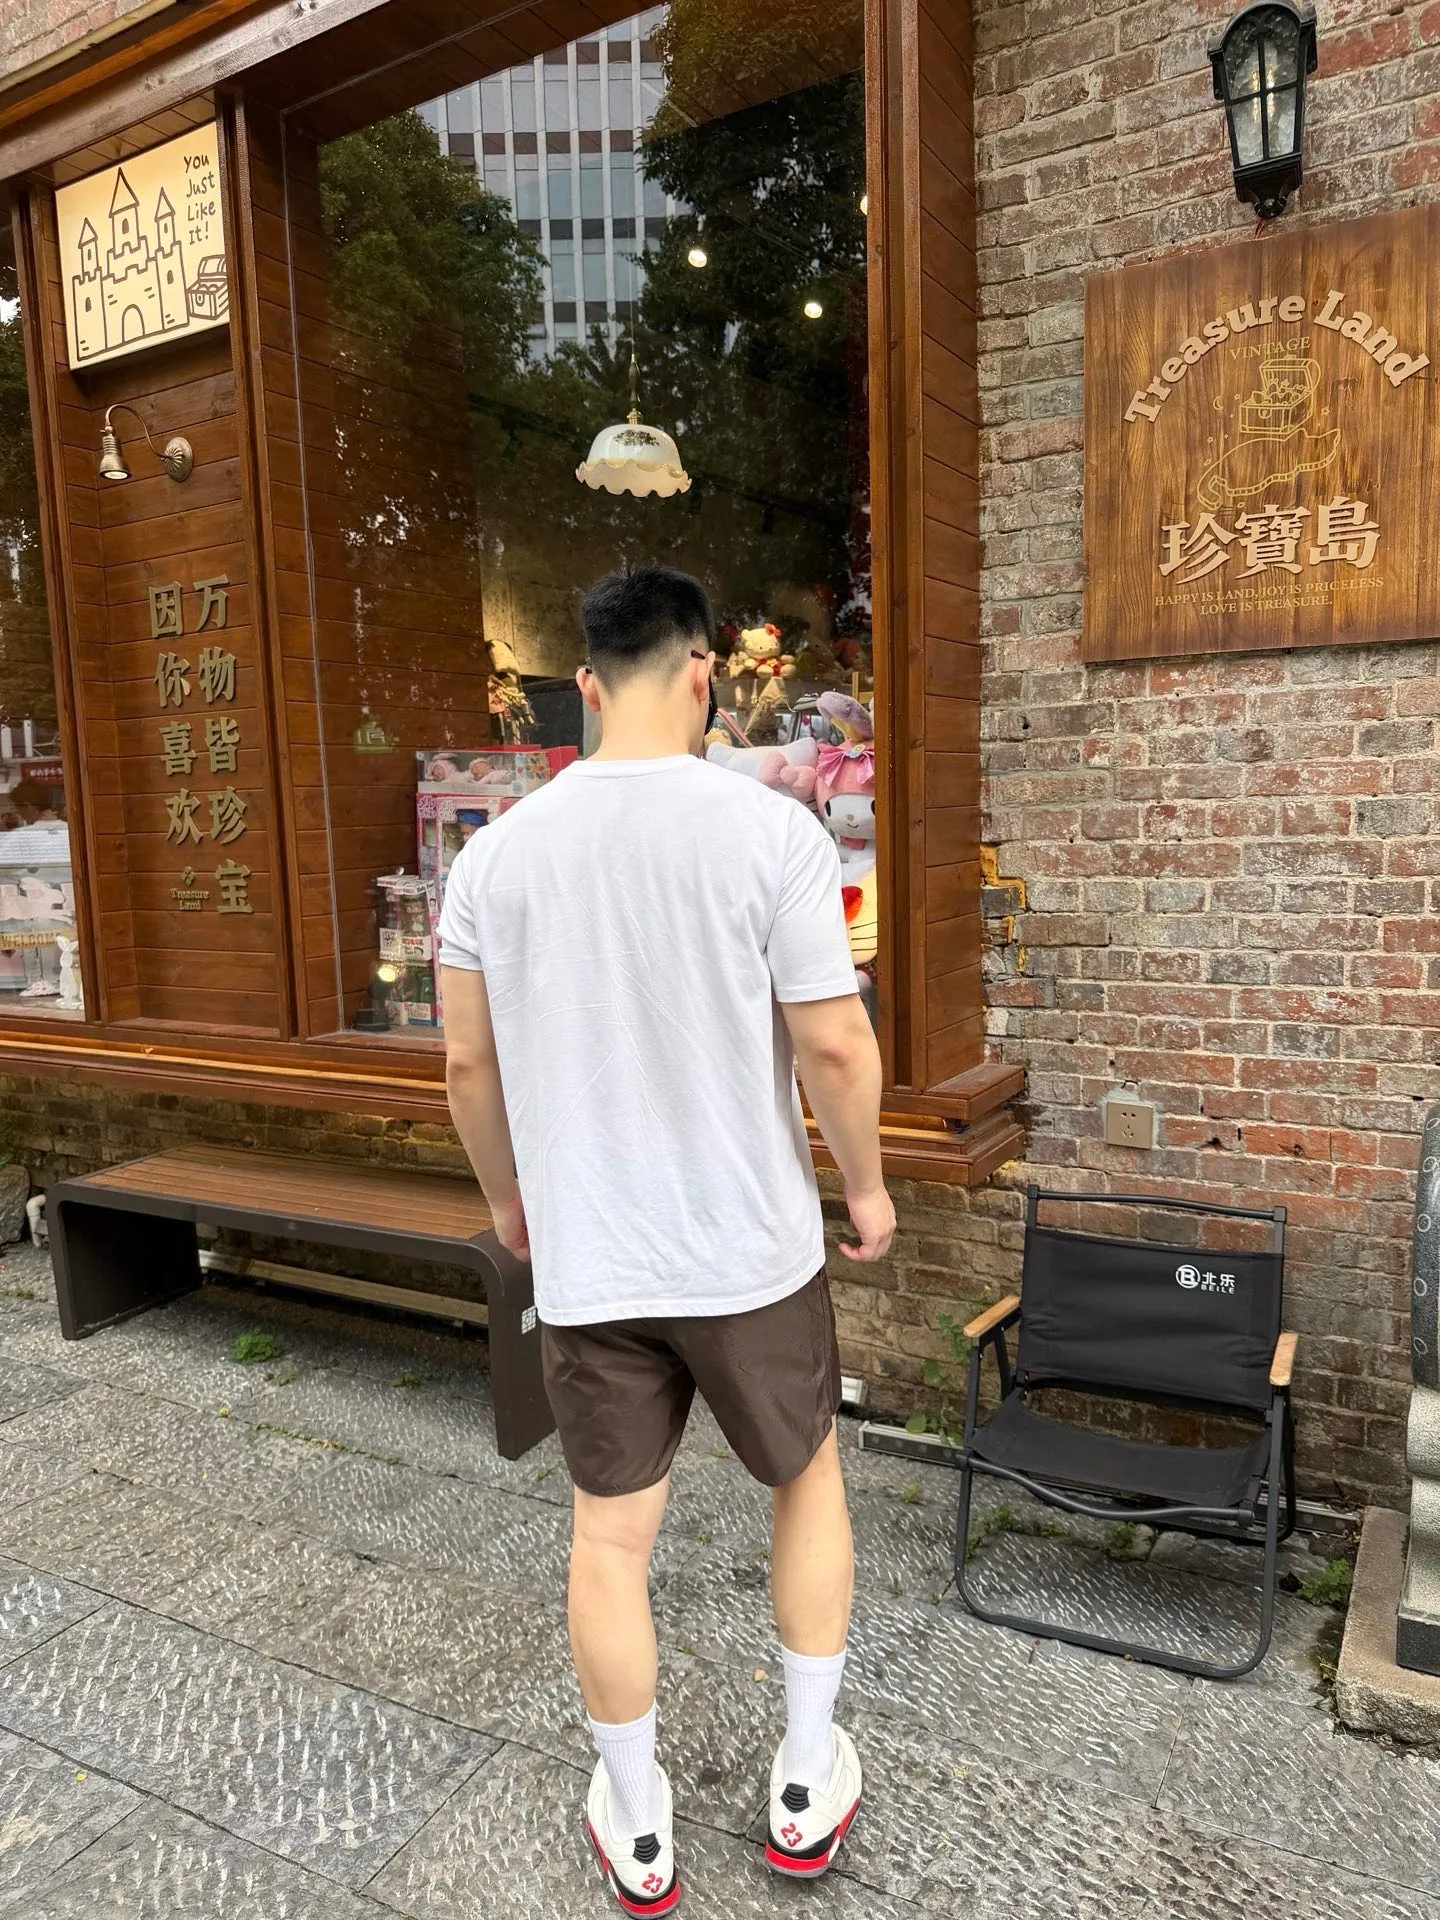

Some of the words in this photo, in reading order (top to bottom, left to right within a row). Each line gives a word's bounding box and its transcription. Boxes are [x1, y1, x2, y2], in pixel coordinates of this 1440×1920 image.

[186, 171, 215, 198] Just
[187, 201, 216, 222] Like
[1123, 293, 1307, 424] Treasure
[1313, 289, 1431, 388] Land
[1230, 335, 1311, 361] VINTAGE
[1158, 495, 1381, 585] 珍寶島
[1155, 593, 1199, 606] HAPPY
[1201, 591, 1214, 602] IS
[1216, 588, 1259, 601] LAND,
[1261, 584, 1289, 599] JOY
[1289, 583, 1303, 595] IS
[1305, 576, 1385, 593] PRICELESS
[1200, 602, 1237, 615] LOVE
[1239, 600, 1253, 612] IS
[1254, 595, 1333, 611] TREASURE.
[148, 580, 204, 846] 因你喜欢
[192, 573, 254, 914] 万物皆珍宝
[170, 888, 210, 900] Treasure
[179, 899, 203, 911] Land
[1200, 1283, 1235, 1295] BEILE
[1202, 1271, 1236, 1288] 北乐
[780, 1822, 803, 1848] 23
[641, 1872, 663, 1894] 23
